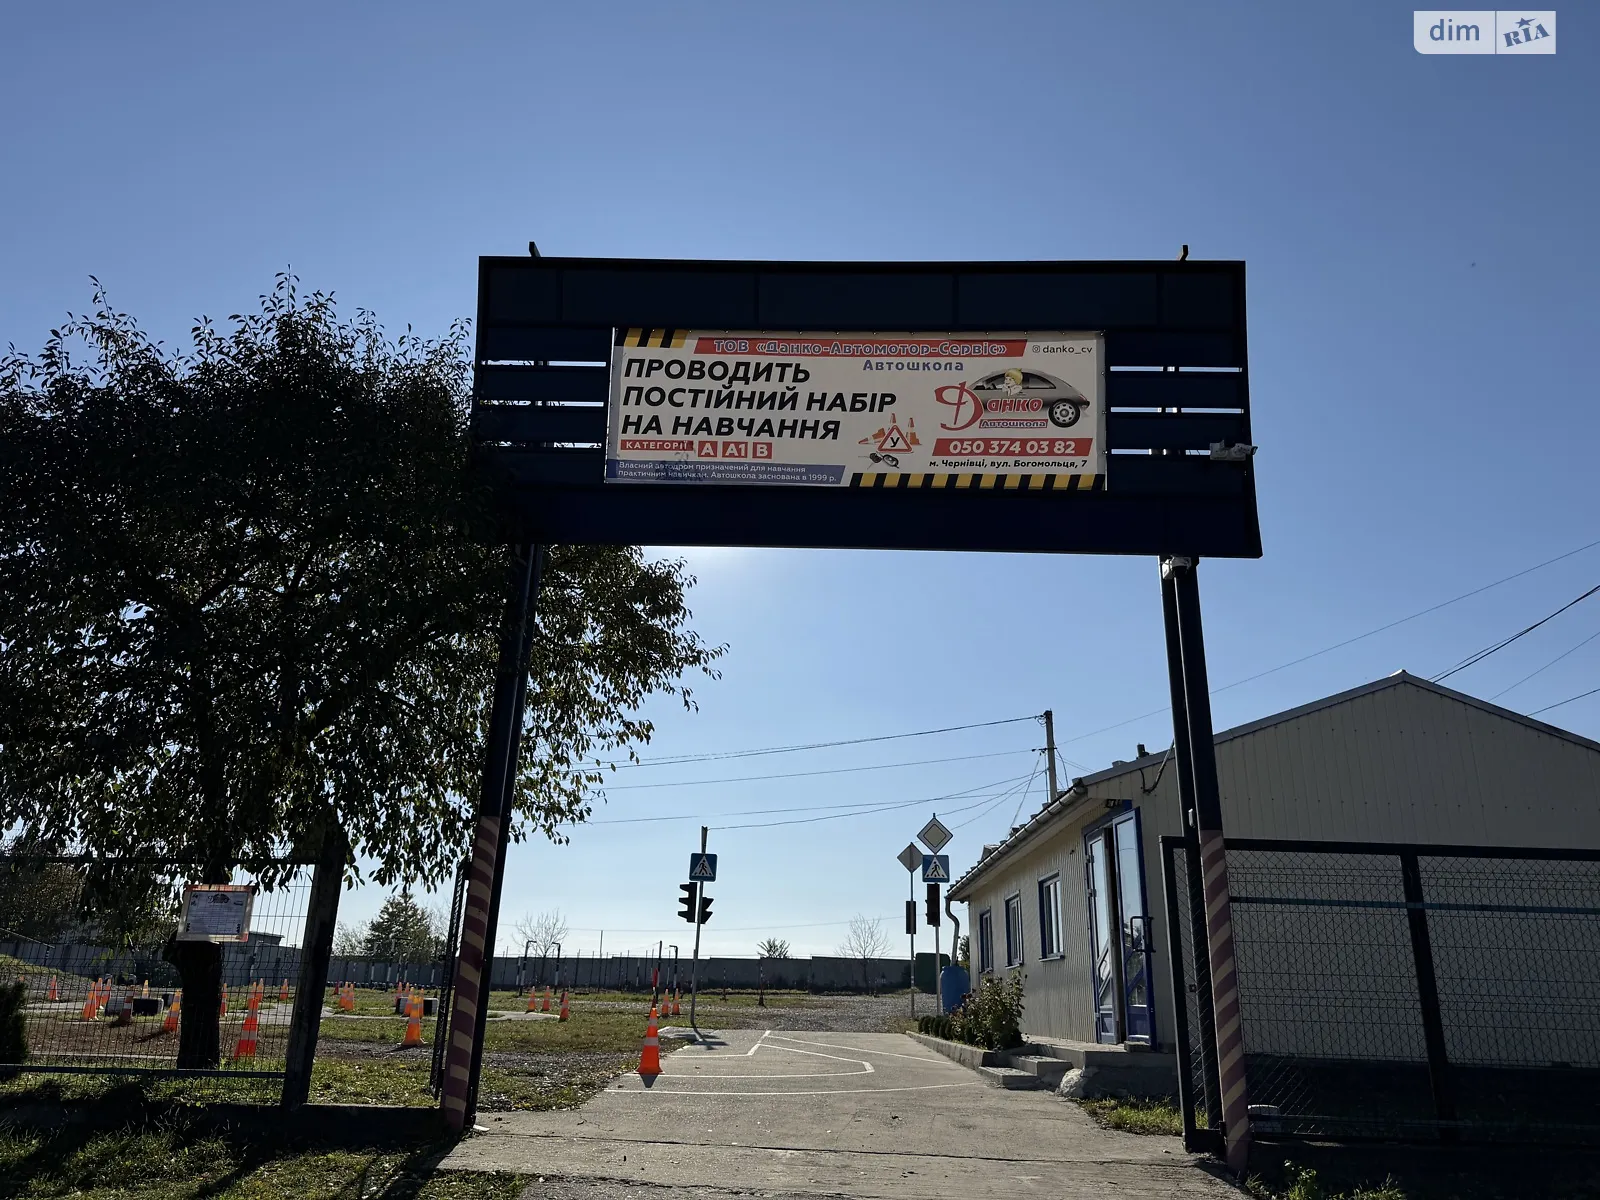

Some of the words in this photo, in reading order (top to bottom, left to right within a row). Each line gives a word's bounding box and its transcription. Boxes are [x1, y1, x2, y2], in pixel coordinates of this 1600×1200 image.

[714, 340, 750, 352] ТОВ
[756, 341, 1008, 357] «Данко-Автомотор-Сервіс»
[1043, 344, 1093, 355] danko_cv
[624, 358, 810, 385] ПРОВОДИТЬ
[863, 359, 964, 372] Автошкола
[622, 384, 800, 411] ПОСТІЙНИЙ
[805, 391, 897, 413] НАБІР
[621, 414, 663, 435] НА
[671, 415, 841, 440] НАВЧАННЯ
[981, 420, 1046, 428] Автошкола
[626, 440, 688, 450] КАТЕГОРІЇ
[949, 440, 984, 454] 050
[988, 440, 1021, 454] 374
[1026, 440, 1049, 454] 03
[1053, 440, 1076, 454] 82
[695, 463, 748, 473] призначений
[750, 465, 766, 473] для
[941, 458, 988, 469] Чернівці,
[1014, 459, 1079, 470] Богомольця,
[1081, 459, 1088, 468] 7
[710, 471, 757, 480] Автошкола
[758, 473, 800, 481] заснована
[808, 473, 828, 481] 1999
